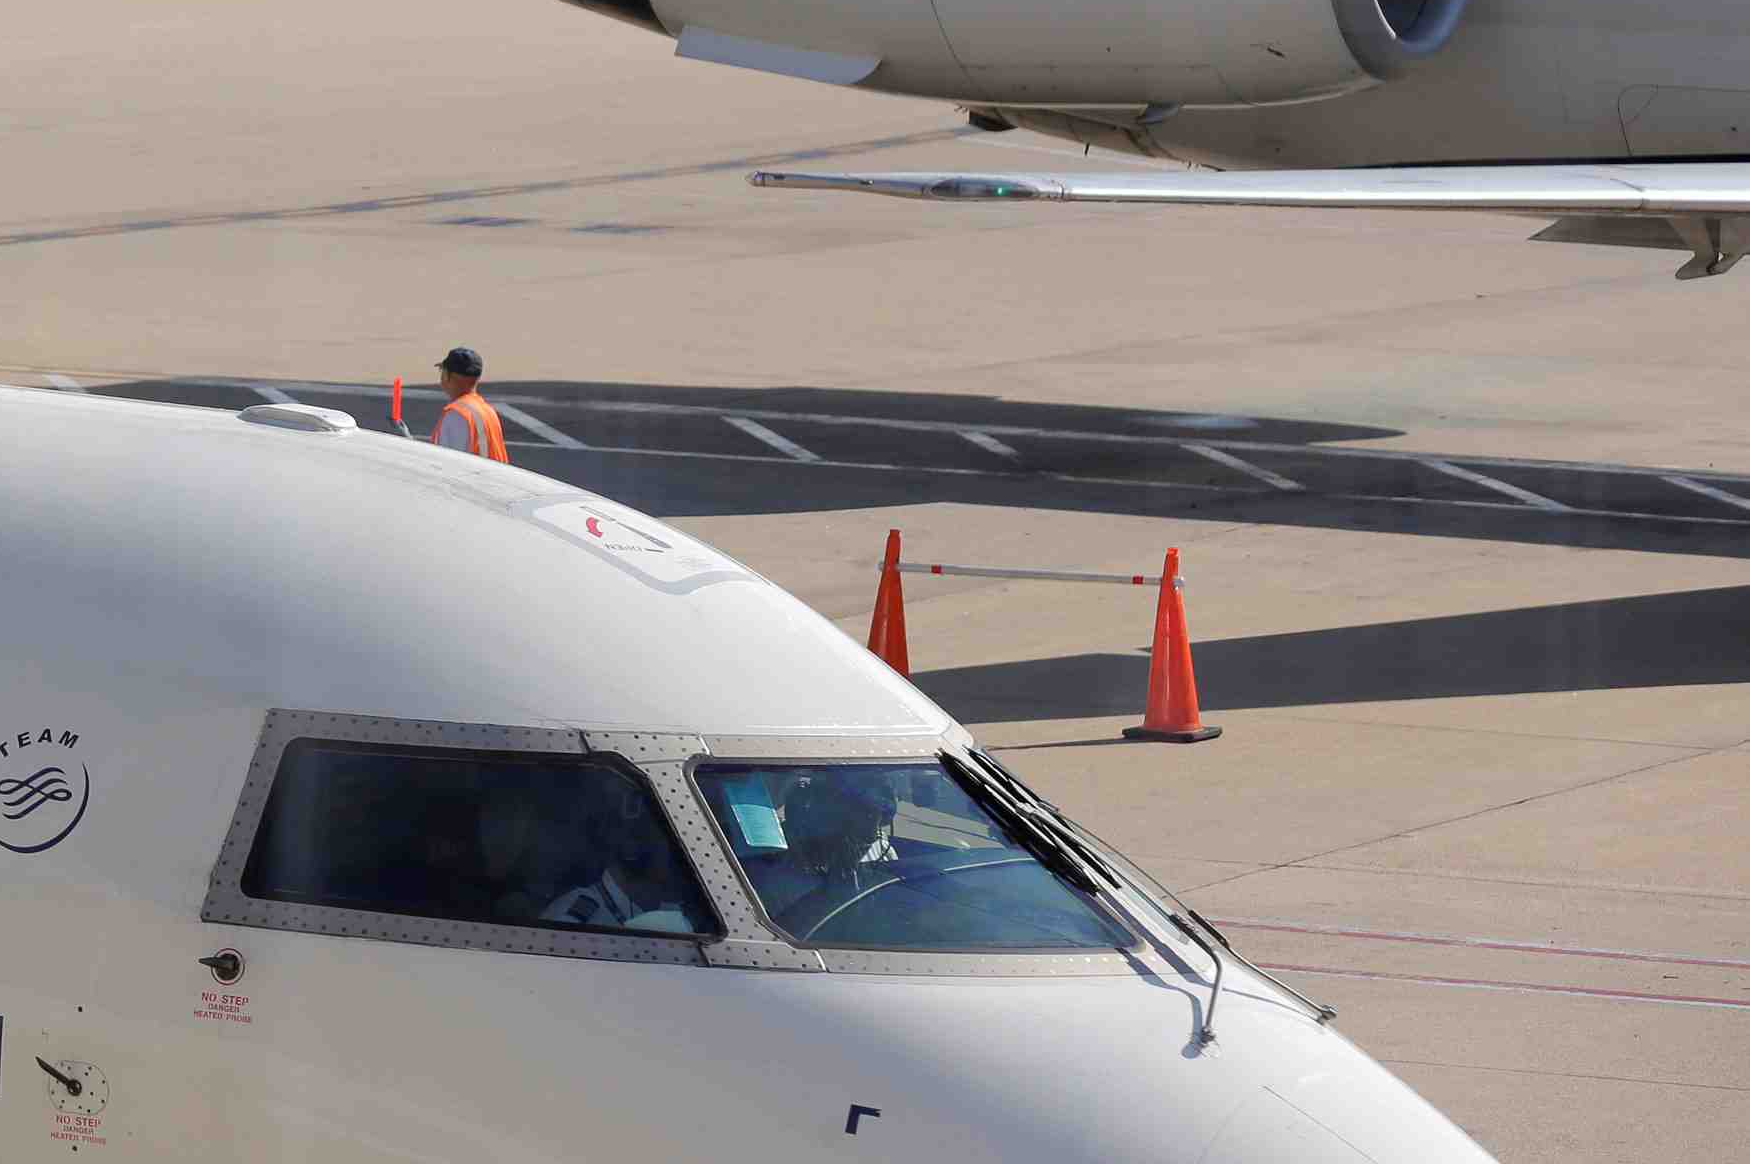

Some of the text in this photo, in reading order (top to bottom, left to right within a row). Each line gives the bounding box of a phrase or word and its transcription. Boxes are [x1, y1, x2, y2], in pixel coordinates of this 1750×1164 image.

[201, 991, 249, 1006] NO STEP
[56, 1115, 102, 1127] NO STEP
